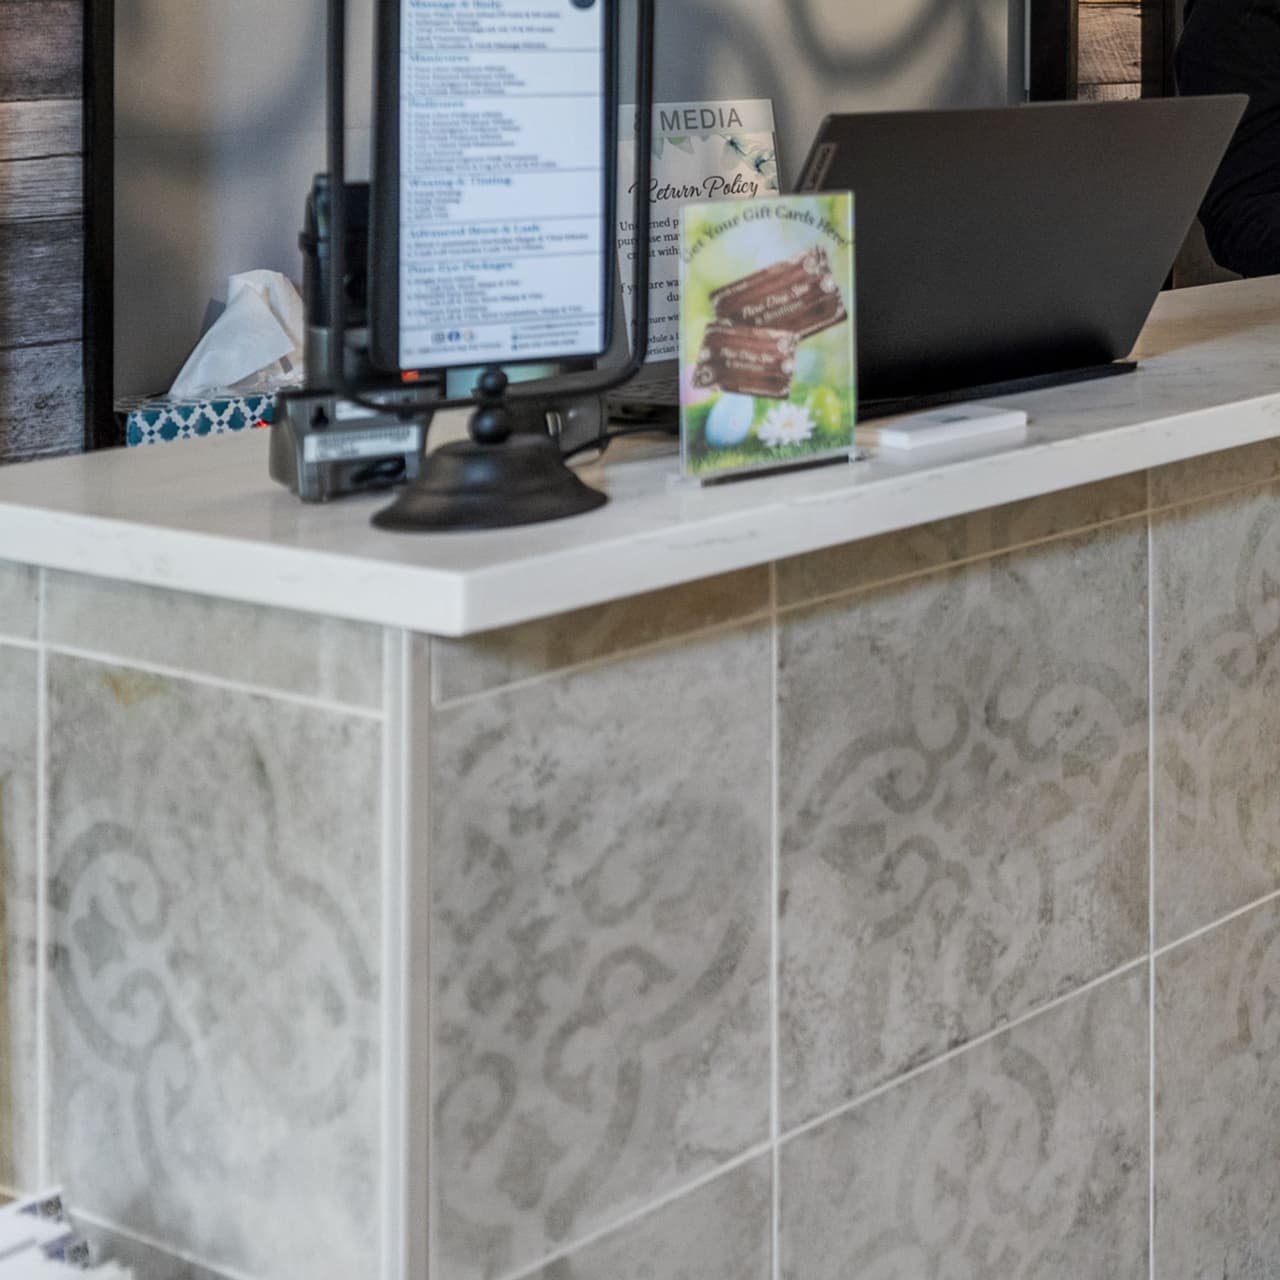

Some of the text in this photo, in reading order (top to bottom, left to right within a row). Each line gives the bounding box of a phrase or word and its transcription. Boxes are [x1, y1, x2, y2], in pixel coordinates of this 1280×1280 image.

[660, 107, 743, 131] MEDIA
[703, 173, 759, 199] Policy
[703, 216, 739, 240] Your
[742, 206, 771, 222] Gift
[775, 205, 815, 225] Cards
